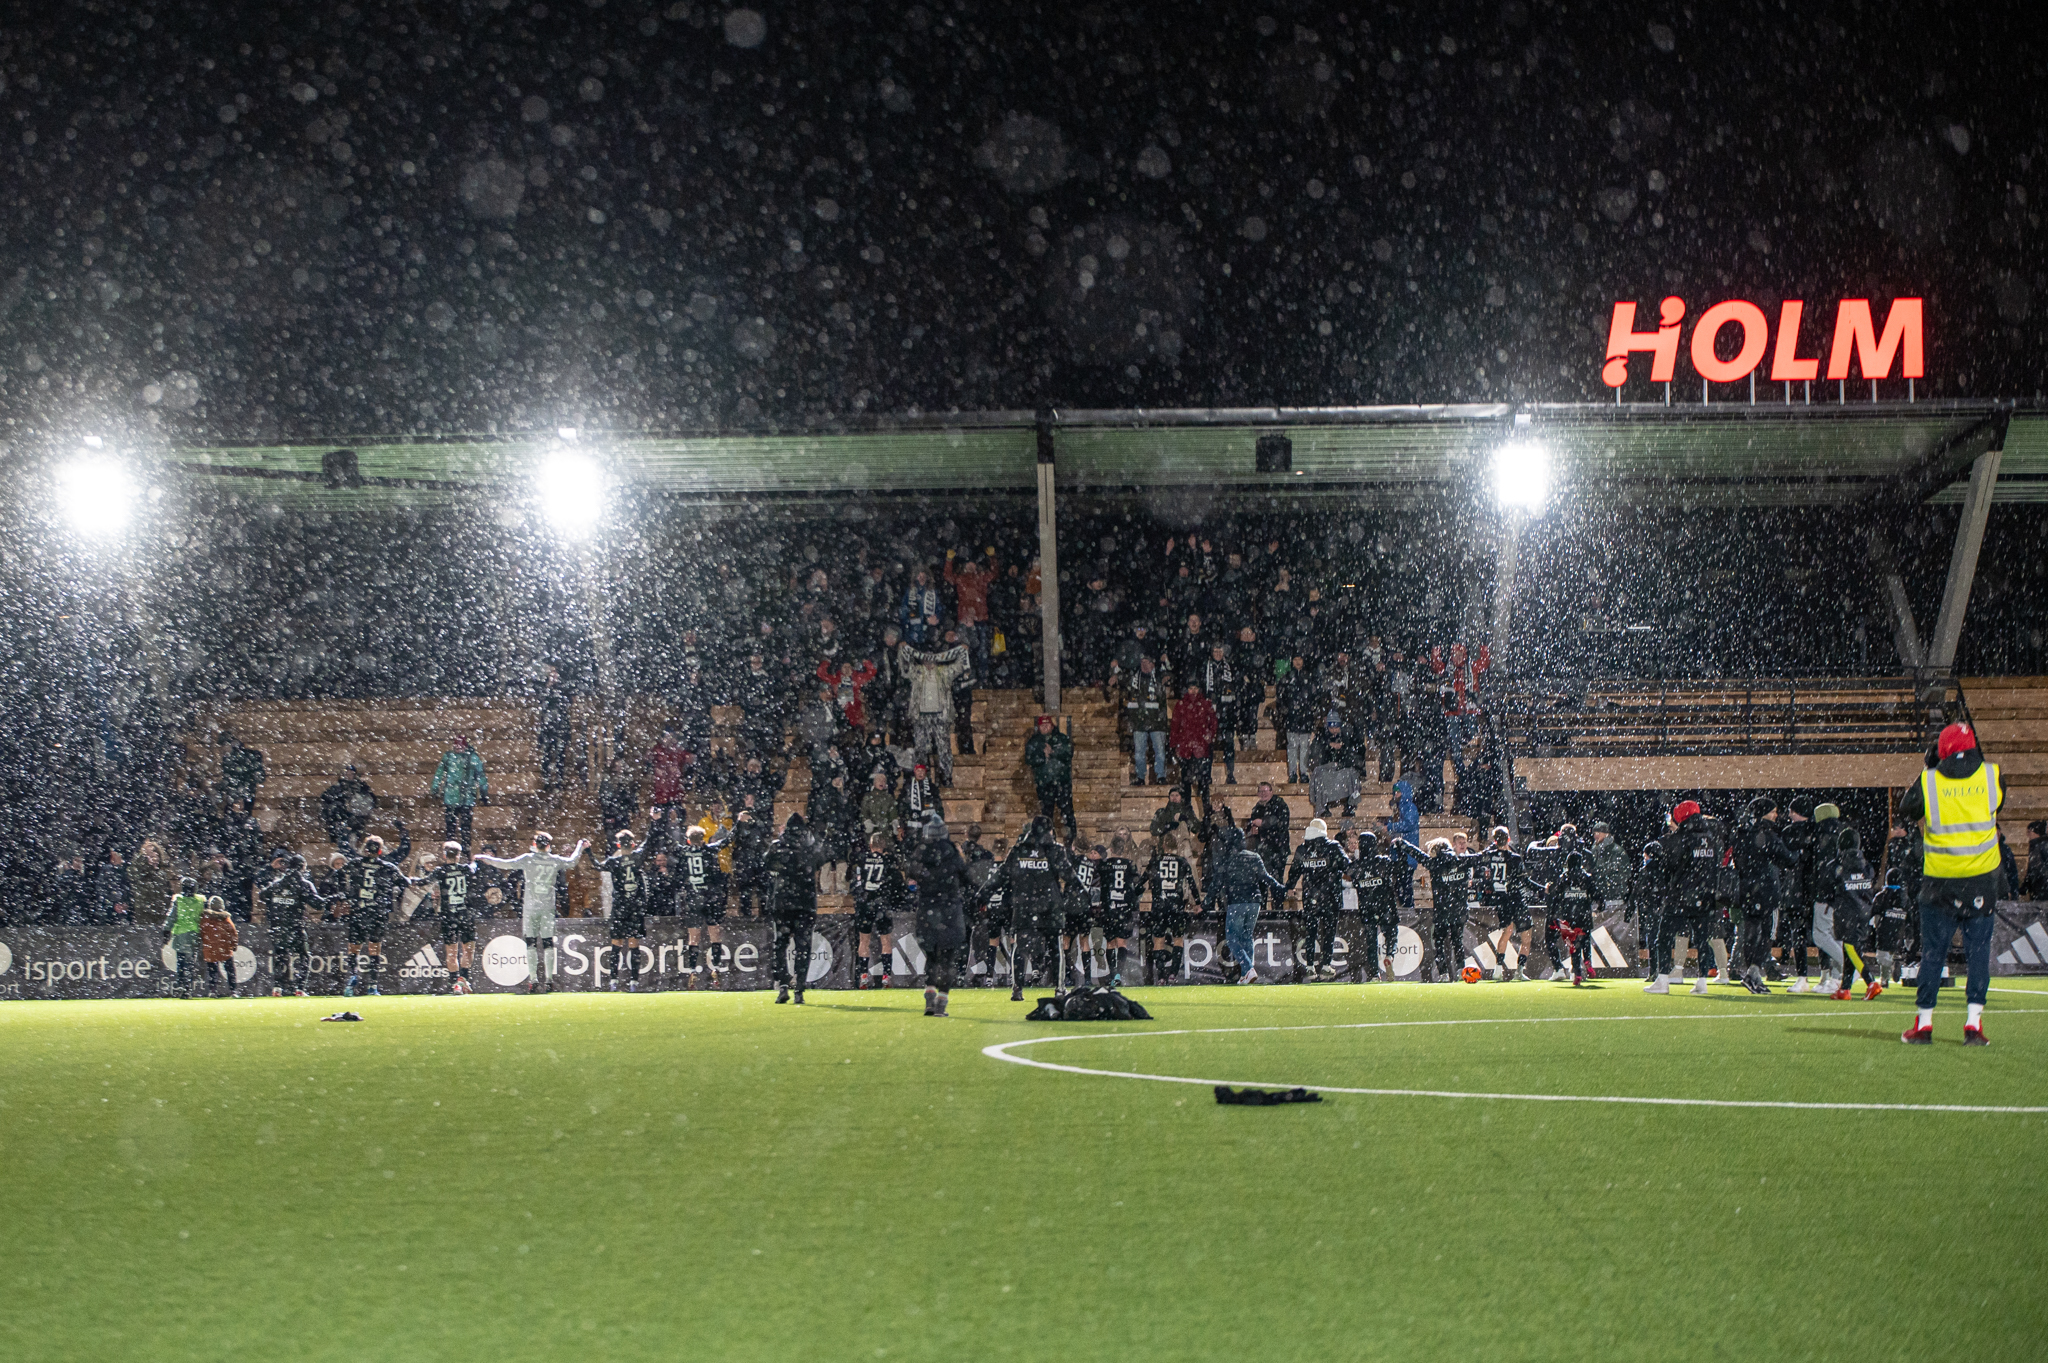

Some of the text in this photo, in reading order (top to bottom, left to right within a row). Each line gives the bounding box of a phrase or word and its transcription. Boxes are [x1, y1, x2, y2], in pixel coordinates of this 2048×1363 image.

[1602, 296, 1924, 388] HOLM
[1942, 785, 1985, 798] WELCO
[1692, 848, 1714, 858] WELCO
[687, 856, 704, 875] 19
[1019, 860, 1049, 870] WELCO
[1159, 861, 1179, 879] 59
[1302, 860, 1327, 868] WELCO
[1490, 862, 1507, 881] 27
[363, 868, 376, 888] 5
[626, 866, 635, 882] 4
[864, 864, 884, 882] 77
[1077, 864, 1095, 886] 95
[1114, 870, 1125, 889] 8
[1441, 872, 1466, 883] WELCO
[445, 875, 468, 896] 20
[1359, 878, 1383, 889] WELCO
[1844, 881, 1873, 891] SANTOS
[1564, 890, 1588, 899] SANTOS
[487, 953, 528, 969] iSport
[552, 934, 759, 988] iSport.ee
[788, 949, 828, 961] iSort
[24, 955, 152, 987] isport.ee
[398, 965, 451, 979] adidas
[156, 975, 206, 996] iSprt
